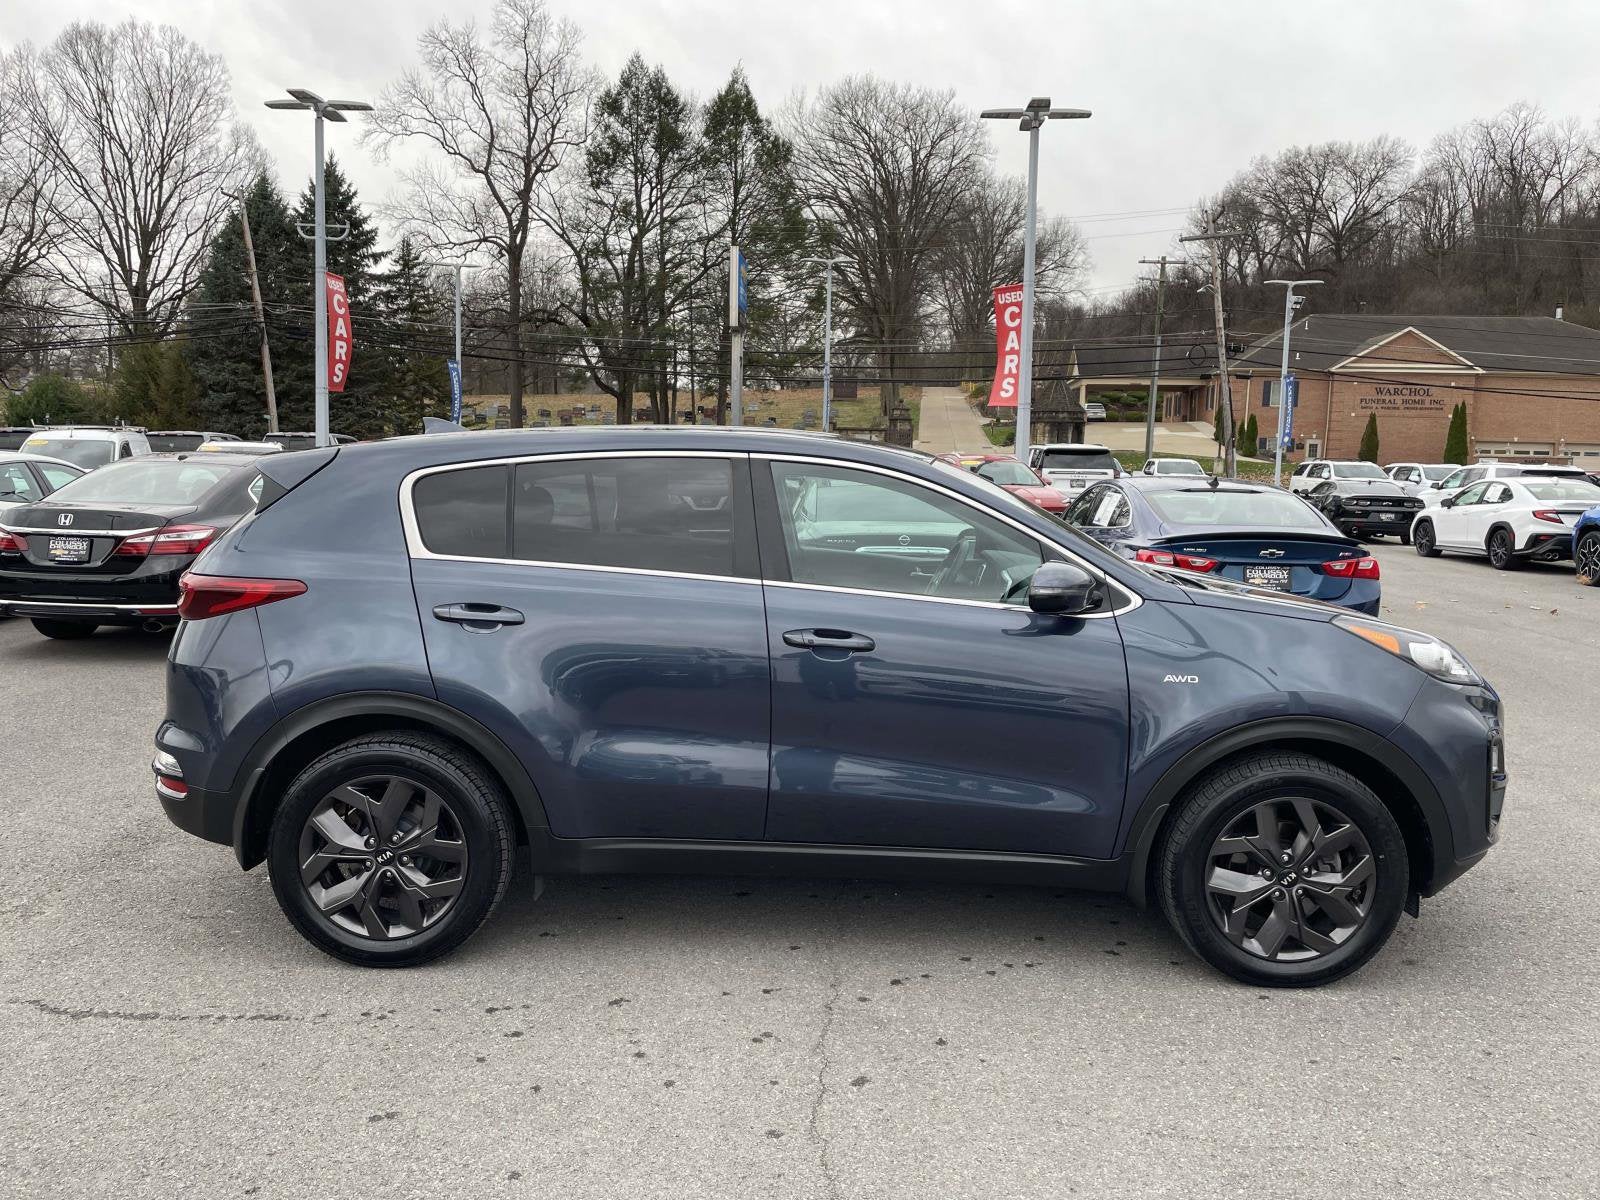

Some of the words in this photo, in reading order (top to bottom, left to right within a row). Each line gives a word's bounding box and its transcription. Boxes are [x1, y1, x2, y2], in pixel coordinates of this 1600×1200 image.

[327, 278, 345, 293] USED
[998, 291, 1023, 305] USED
[333, 294, 347, 383] CARS
[1000, 306, 1021, 397] CARS
[1375, 387, 1433, 397] WARCHOL
[1163, 674, 1199, 683] AWD
[377, 851, 393, 863] KIA
[1280, 872, 1297, 885] KIA
